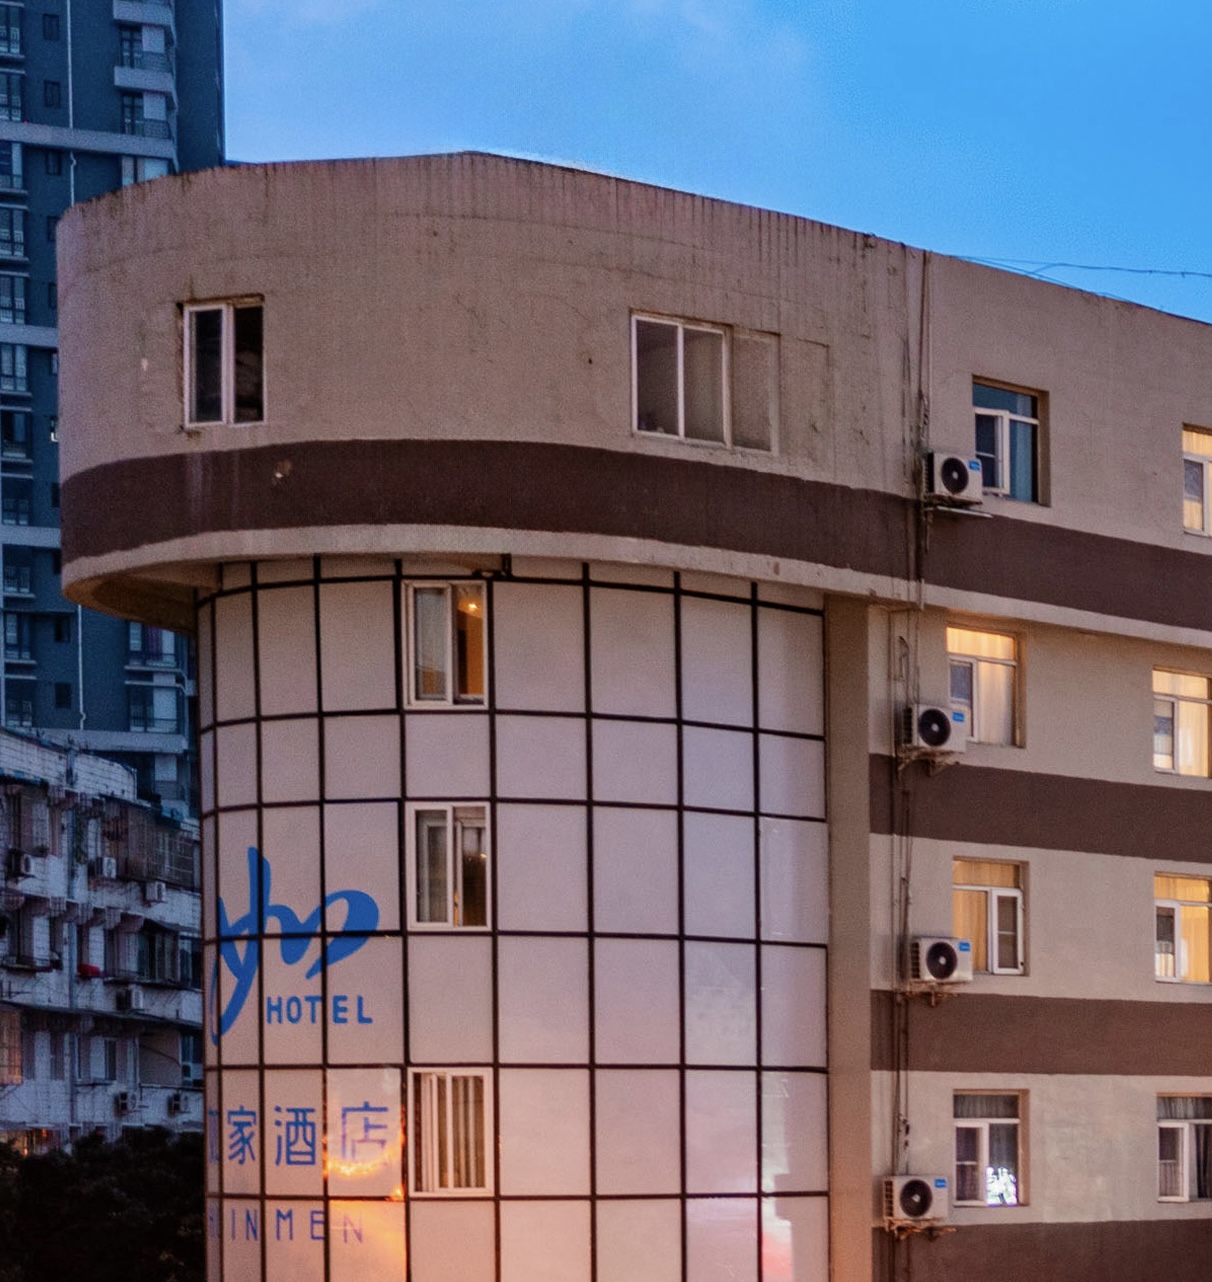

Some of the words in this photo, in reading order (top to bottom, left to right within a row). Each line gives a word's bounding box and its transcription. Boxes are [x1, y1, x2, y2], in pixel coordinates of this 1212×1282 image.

[266, 995, 373, 1024] HOTEL
[207, 1101, 389, 1166] 家酒店
[206, 1208, 364, 1244] INMEN
